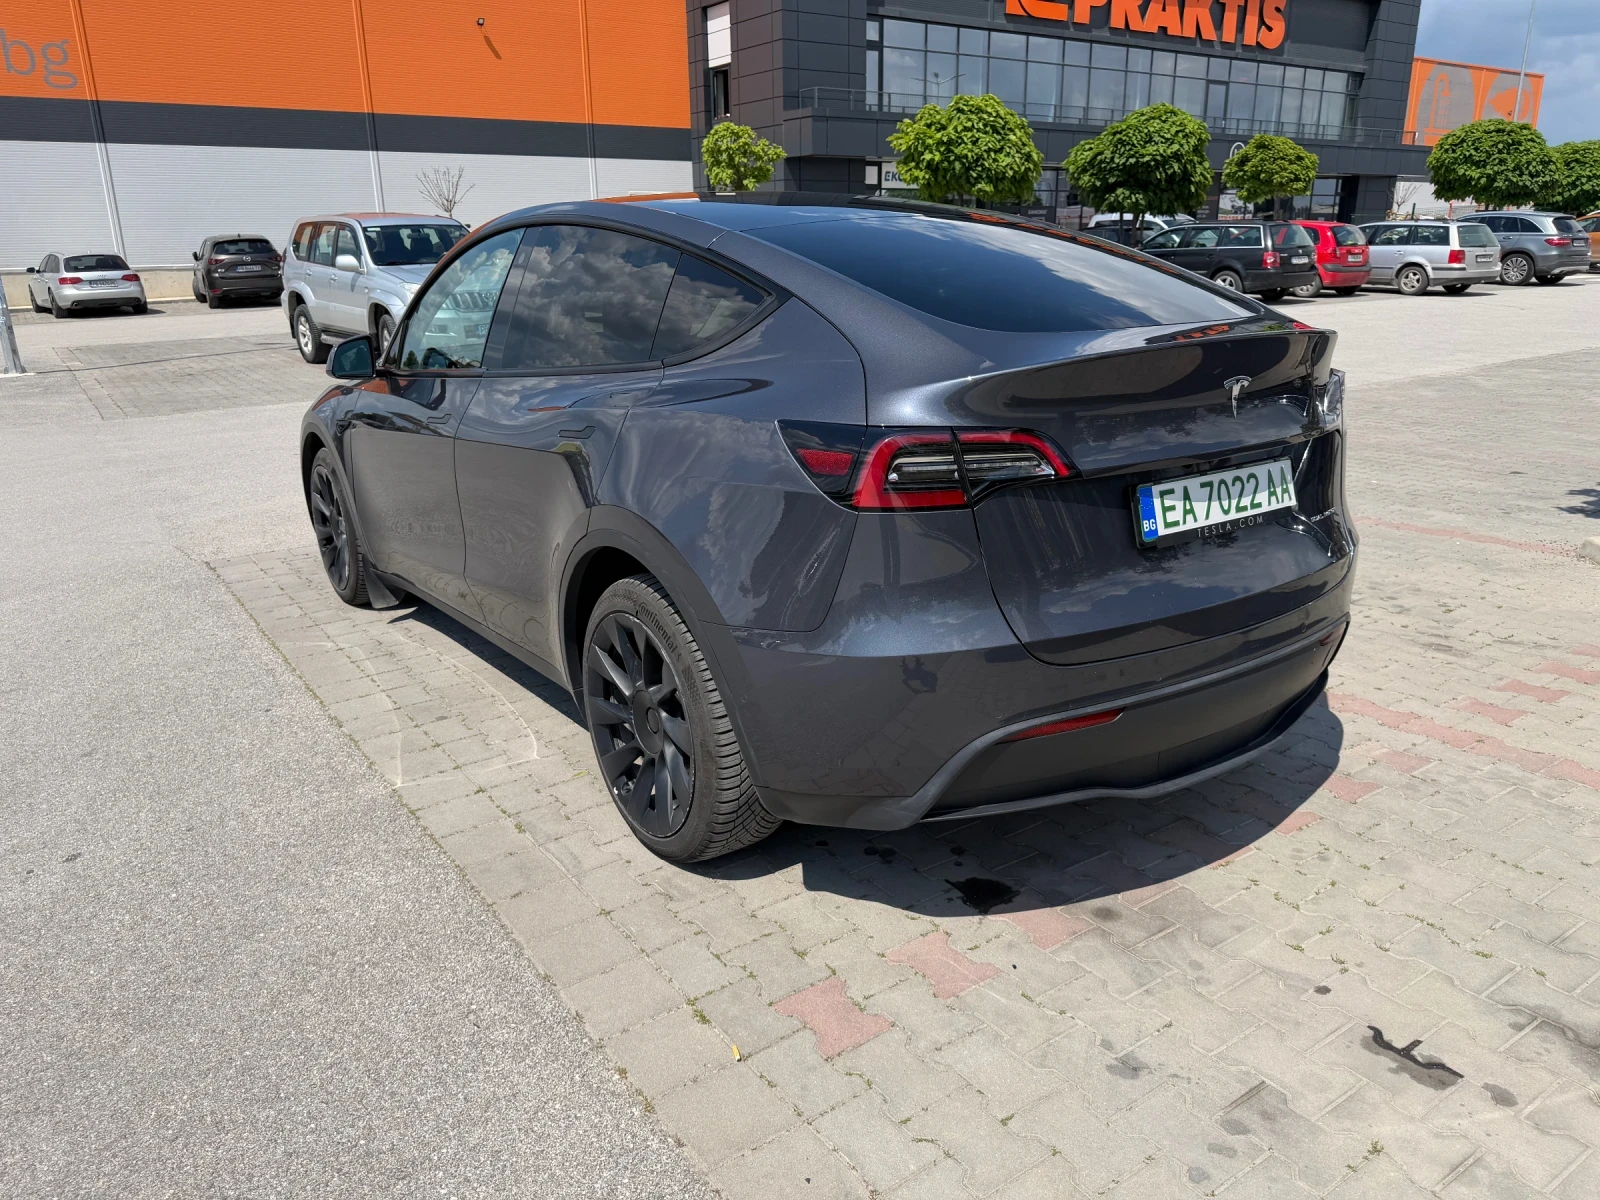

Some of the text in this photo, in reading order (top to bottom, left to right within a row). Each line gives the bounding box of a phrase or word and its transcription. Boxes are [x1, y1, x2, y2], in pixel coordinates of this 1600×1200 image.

[0, 28, 78, 90] bg
[1142, 518, 1157, 532] BG
[1197, 514, 1264, 538] TESLA.COM
[637, 601, 679, 654] Continental
